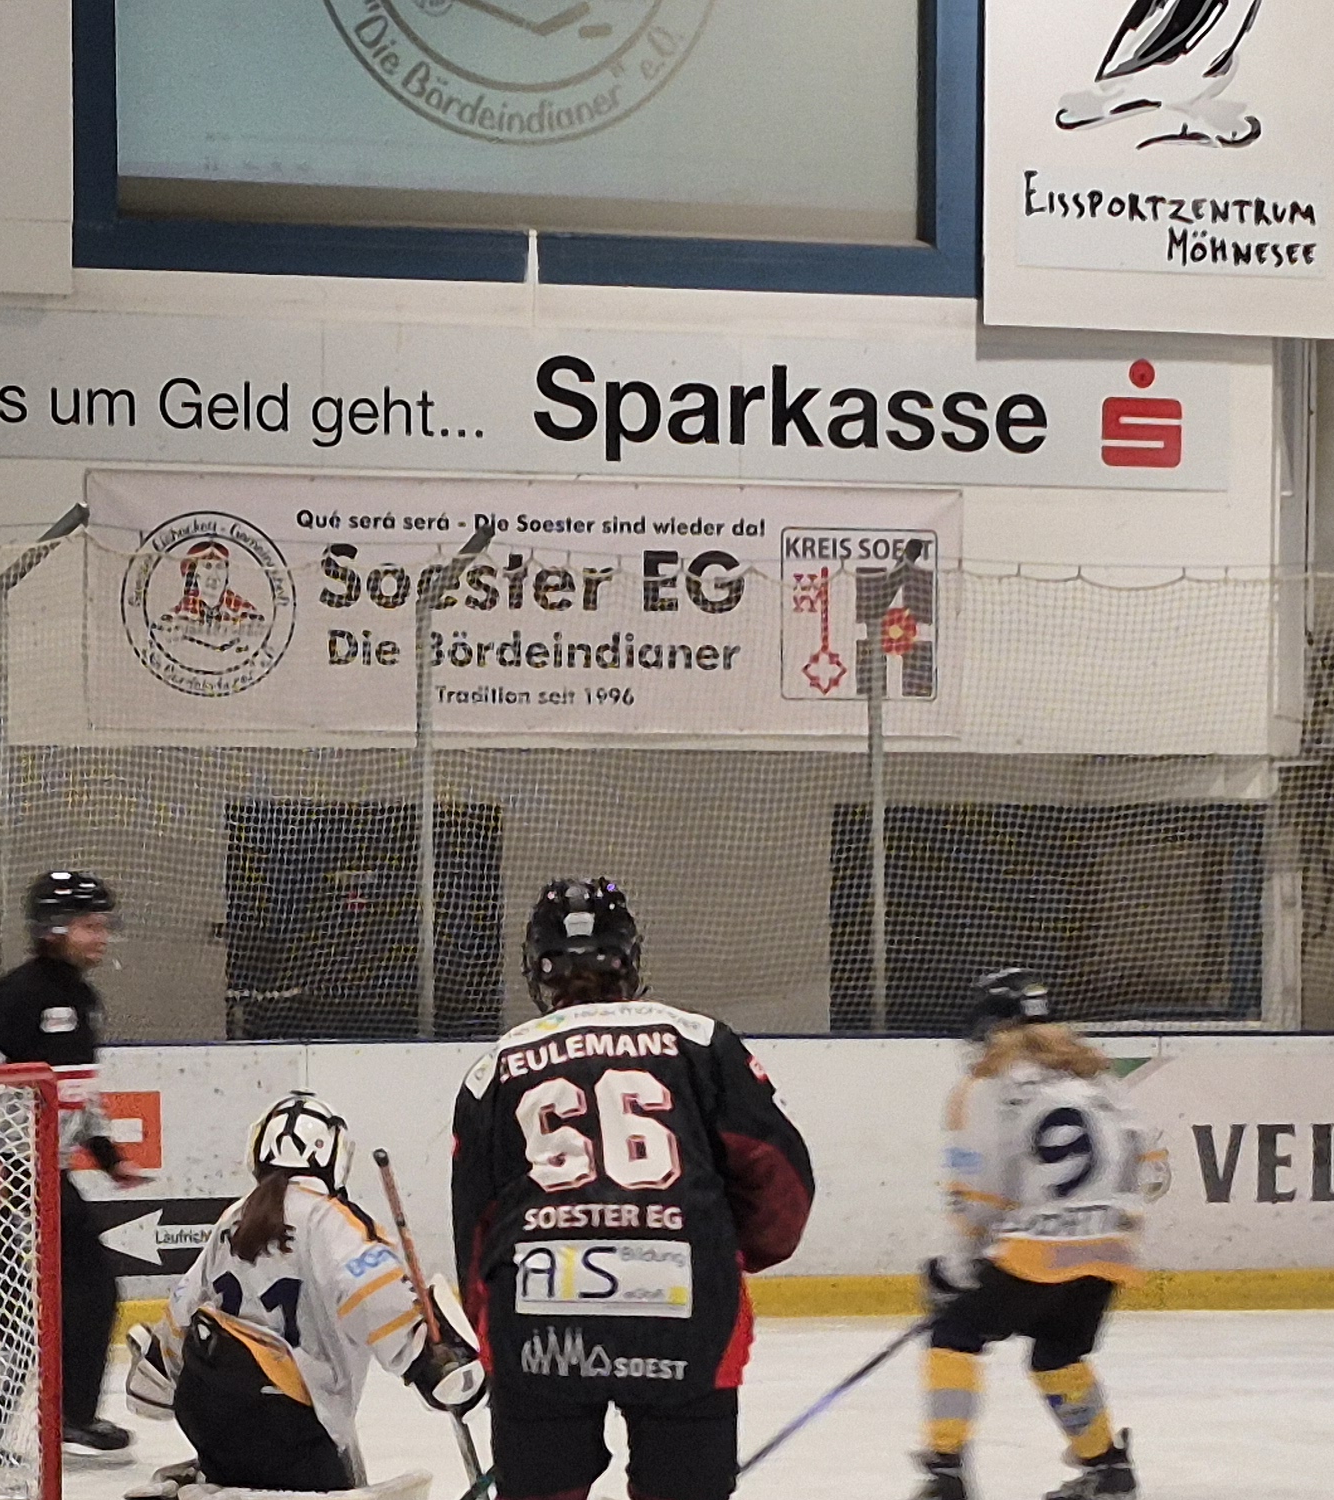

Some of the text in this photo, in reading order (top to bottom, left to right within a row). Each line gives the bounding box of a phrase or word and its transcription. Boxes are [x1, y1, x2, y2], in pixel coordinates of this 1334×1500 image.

[50, 385, 136, 427] um
[159, 377, 289, 432] Geld
[312, 385, 485, 447] geht...
[533, 355, 1048, 461] Sparkasse
[516, 514, 593, 534] Soester
[602, 514, 646, 535] sind
[652, 516, 727, 536] wieder
[785, 536, 934, 561] KREIS SOET
[318, 543, 746, 614] Soester EG
[327, 629, 401, 667] Die
[428, 630, 742, 671] Bördeindianer
[435, 684, 531, 705] Tradition
[585, 687, 635, 706] 1996
[1034, 1107, 1093, 1197] 9
[523, 1204, 684, 1232] SOESTER EG
[613, 1357, 689, 1381] SOEST
